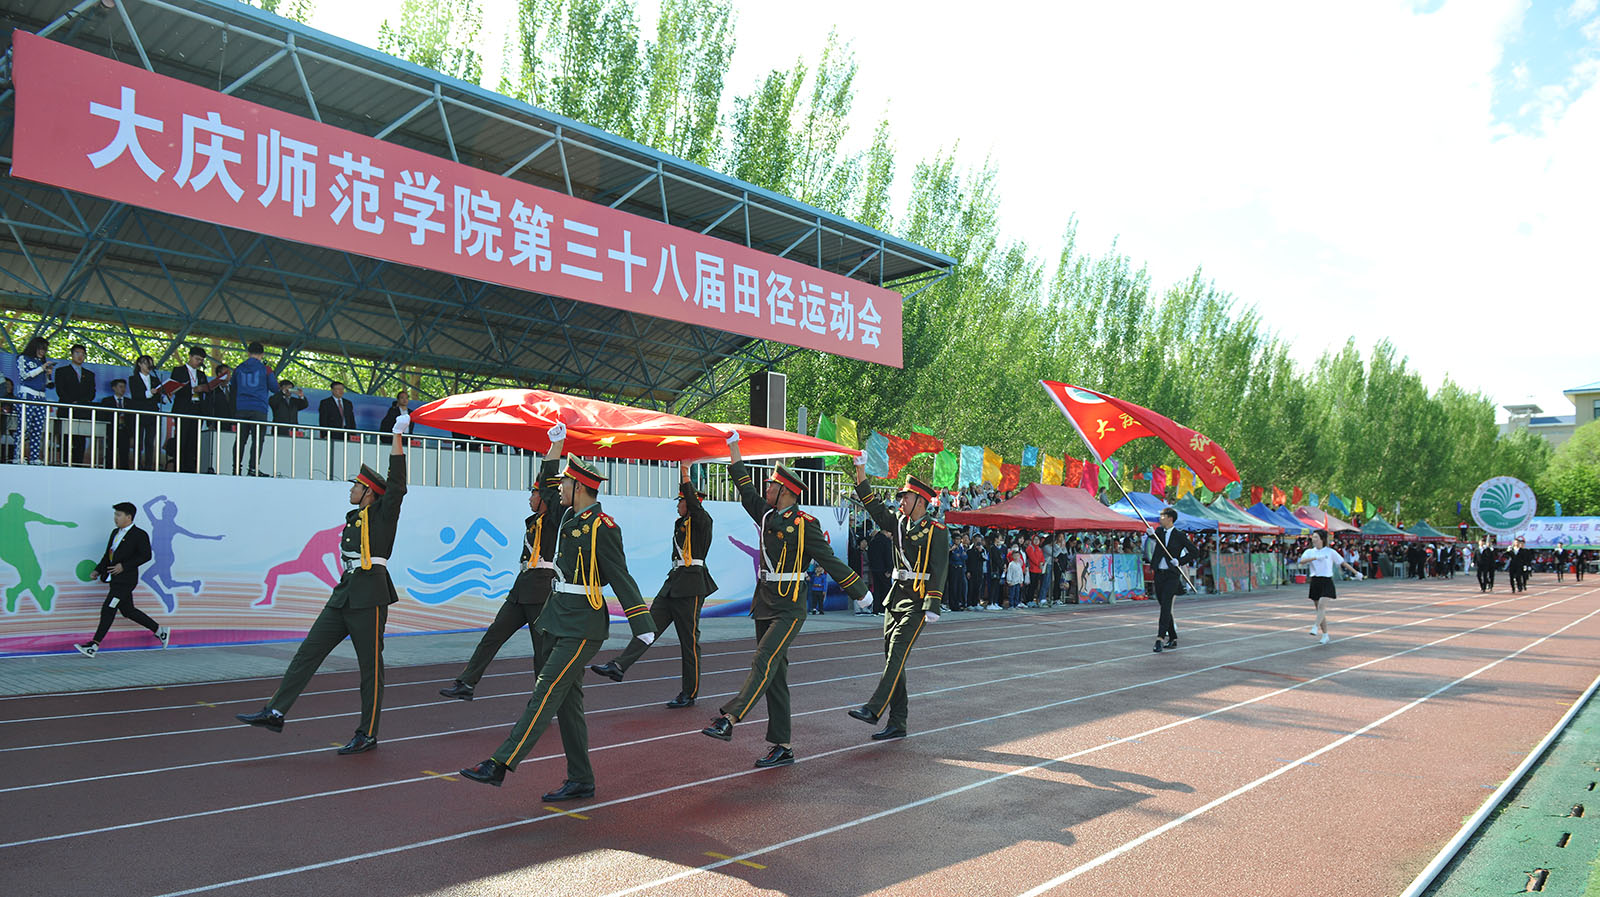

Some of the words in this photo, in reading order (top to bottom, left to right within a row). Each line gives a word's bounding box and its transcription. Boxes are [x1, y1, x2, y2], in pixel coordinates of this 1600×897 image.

[86, 86, 882, 348] 大庆师范学院第三十八届田径运动会
